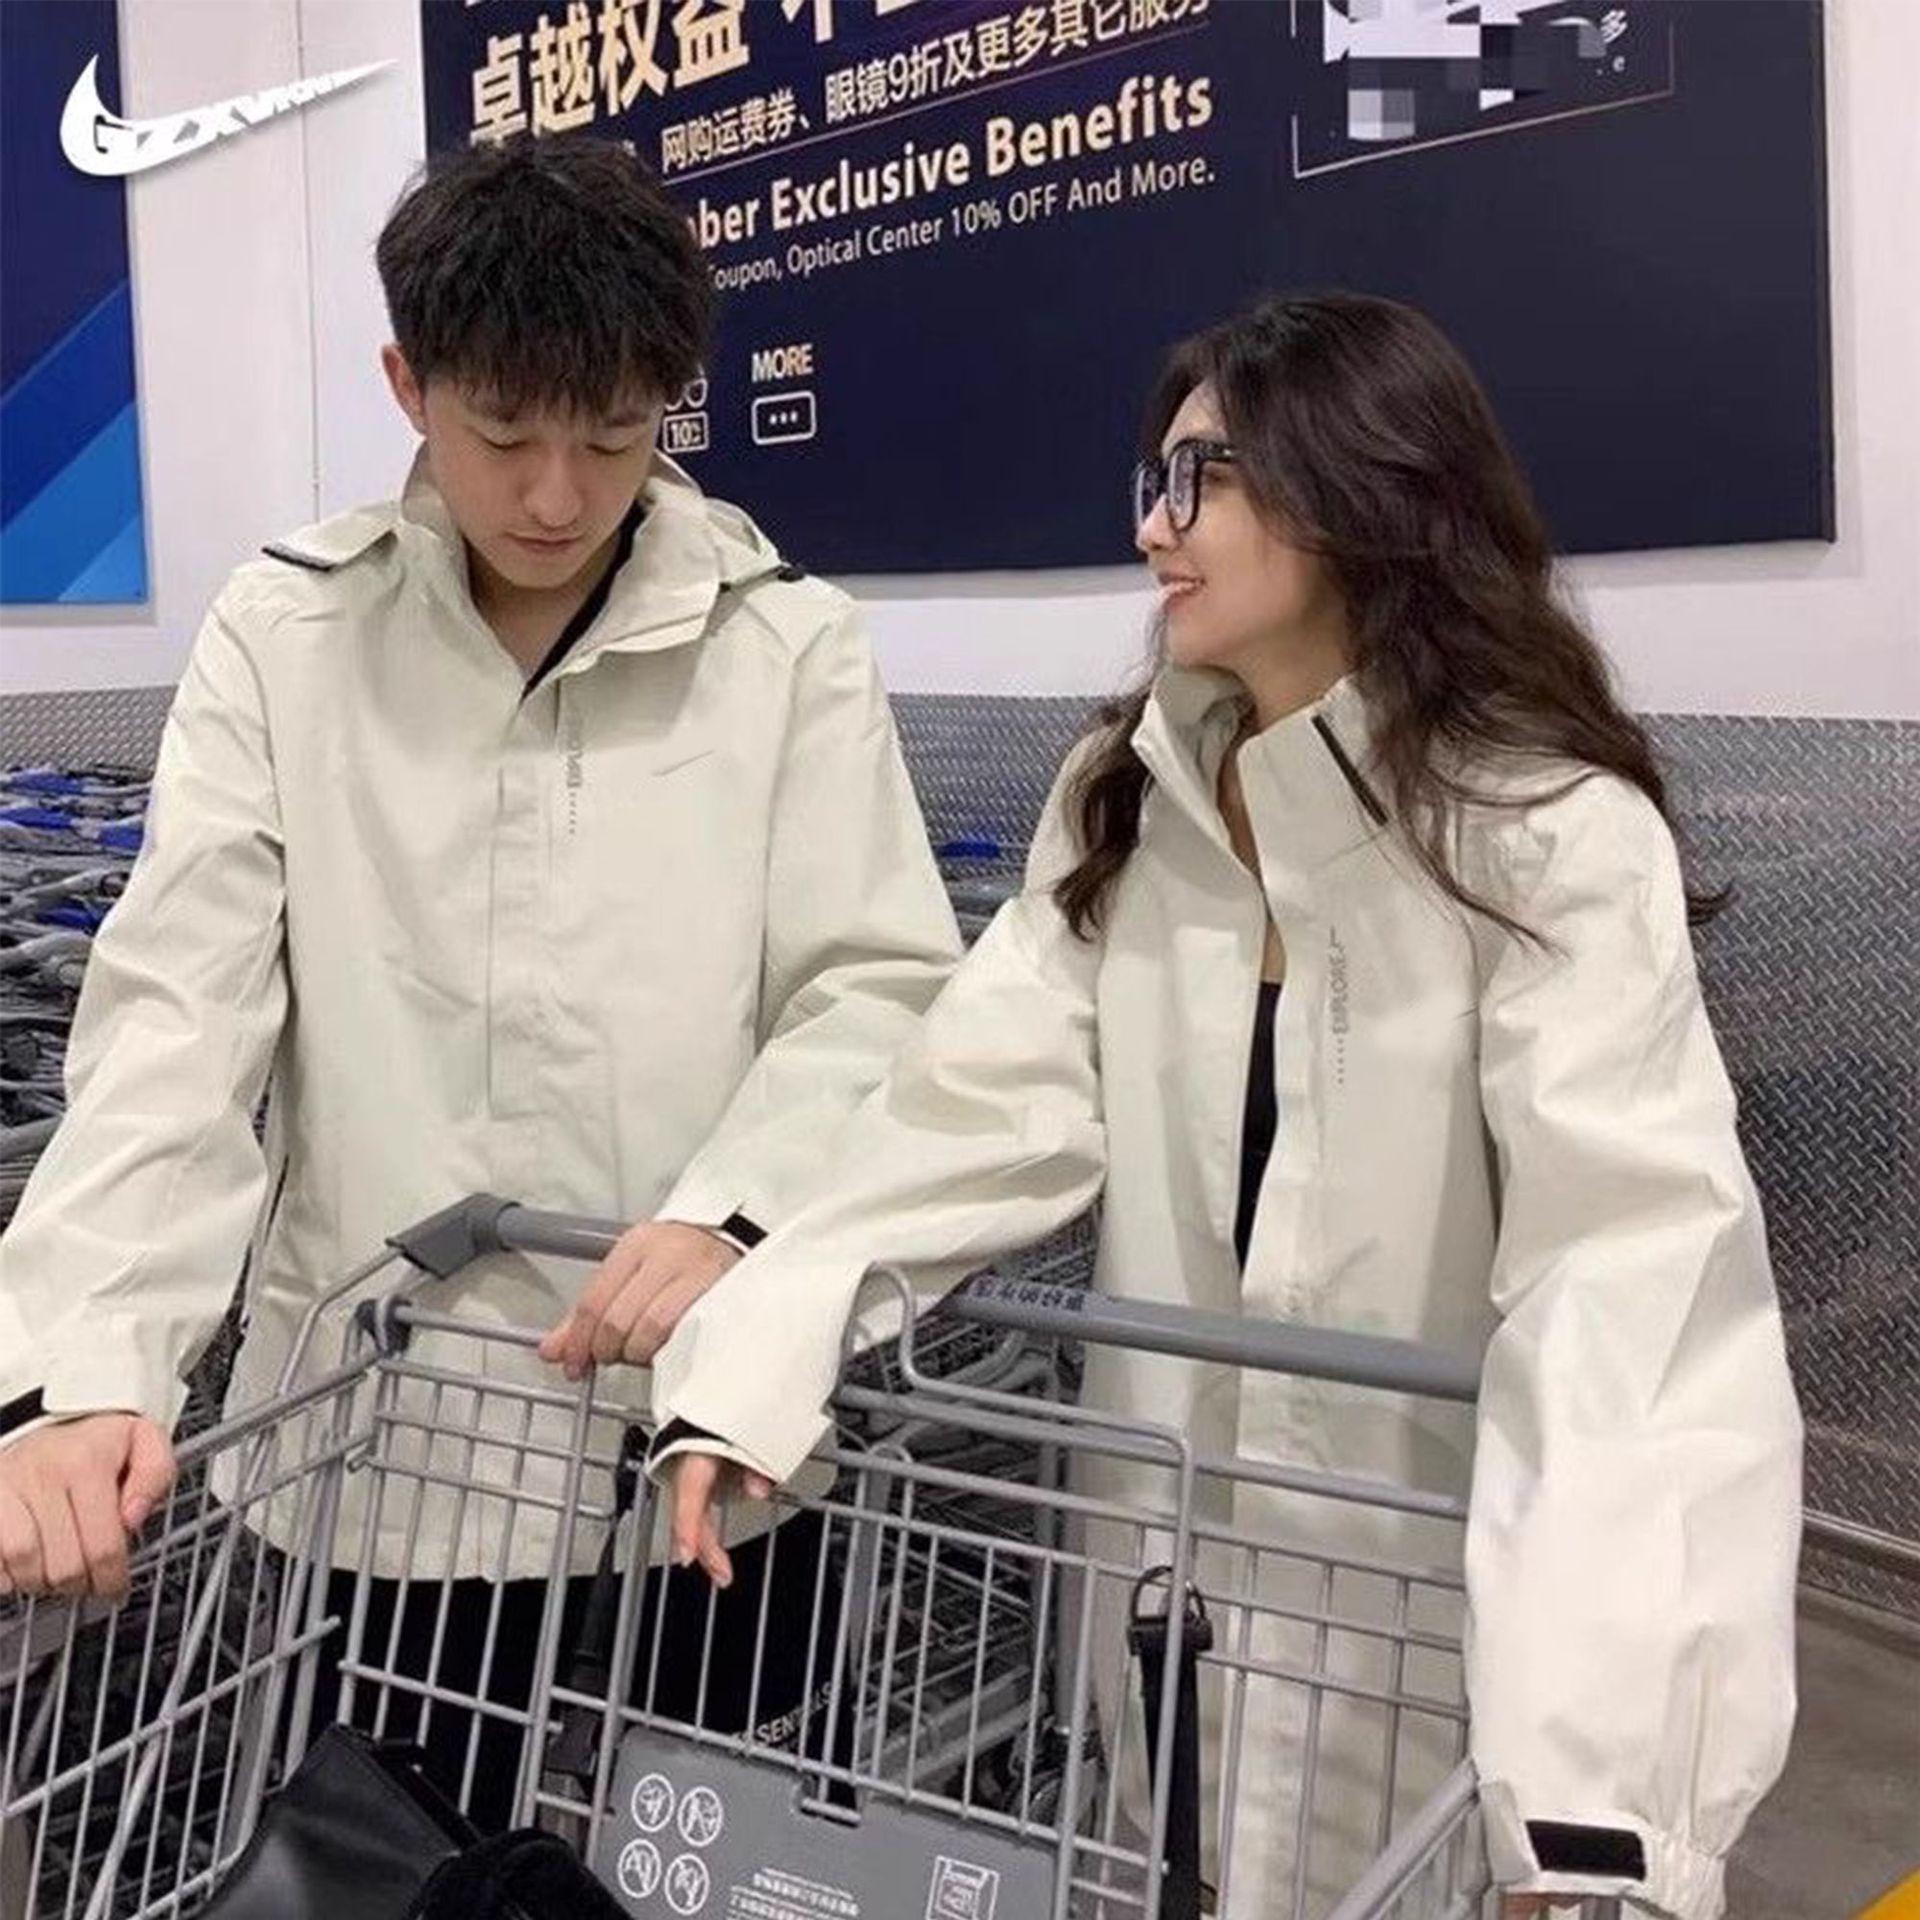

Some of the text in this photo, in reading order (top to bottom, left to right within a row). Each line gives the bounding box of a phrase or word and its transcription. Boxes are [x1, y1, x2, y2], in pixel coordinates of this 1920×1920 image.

[771, 141, 969, 231] Exclusive
[985, 74, 1213, 177] Benefits
[707, 156, 1216, 291] oupon, Optical Center 10% OFF And More.
[751, 343, 814, 383] MORE
